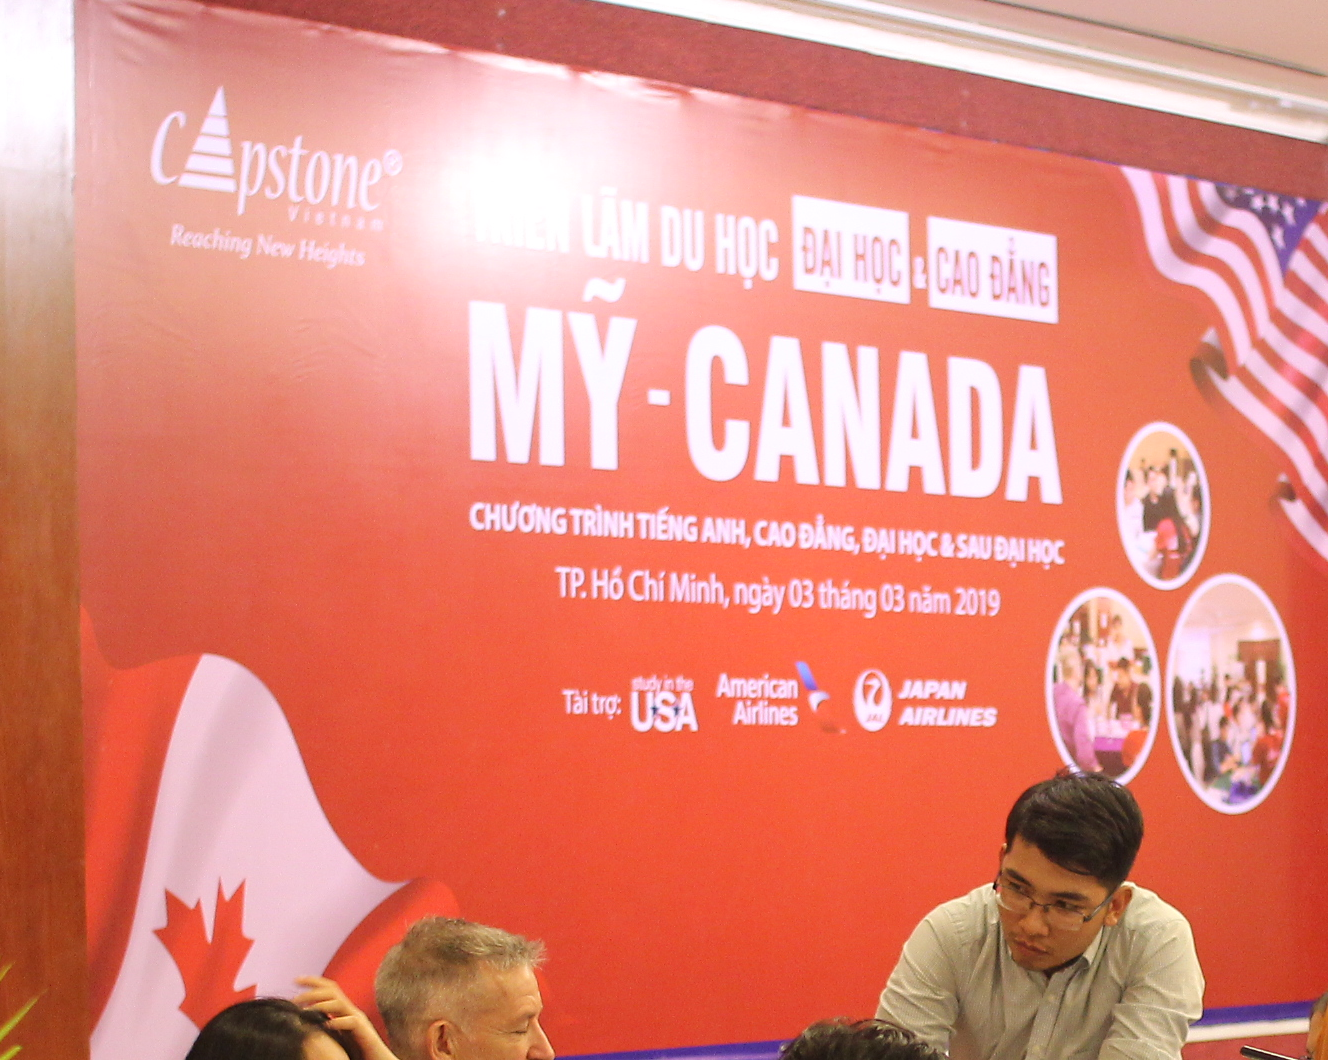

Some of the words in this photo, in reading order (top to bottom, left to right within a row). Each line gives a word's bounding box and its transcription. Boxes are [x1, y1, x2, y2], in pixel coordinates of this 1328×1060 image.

[287, 205, 385, 231] Vietnam
[169, 223, 253, 260] Reaching
[256, 233, 296, 258] New
[298, 238, 367, 270] Heights
[660, 204, 705, 273] DU
[714, 212, 780, 290] HỌC
[801, 225, 842, 288] ĐẠI
[854, 232, 902, 296] HỌC
[935, 244, 980, 299] CAO
[684, 324, 1064, 506] CANADA
[469, 501, 568, 535] CHƯƠNG
[569, 504, 635, 539] TRÌNH
[636, 506, 698, 542] TIẾNG
[701, 516, 752, 548] ANH,
[753, 519, 796, 549] CAO
[862, 526, 896, 560] ĐẠI
[898, 530, 938, 562] HỌC
[941, 533, 955, 558] &
[957, 534, 993, 560] SAU
[994, 536, 1026, 568] ĐẠI
[1027, 539, 1065, 570] HỌC
[555, 566, 587, 599] TP.
[628, 570, 666, 602] Chí
[669, 571, 730, 608] Minh,
[733, 575, 785, 614] ngày
[788, 578, 815, 608] 03
[817, 578, 878, 618] tháng
[880, 583, 905, 612] 03
[908, 584, 951, 614] năm
[954, 586, 1001, 616] 2019
[631, 675, 662, 692] study
[664, 675, 674, 691] in
[675, 675, 695, 691] the
[716, 672, 799, 699] American
[897, 679, 968, 700] JAPAN
[562, 688, 588, 715] Tài
[592, 689, 623, 720] trợ:
[629, 691, 699, 733] USA
[732, 700, 799, 727] Airlines
[898, 705, 999, 727] AIRLINES
